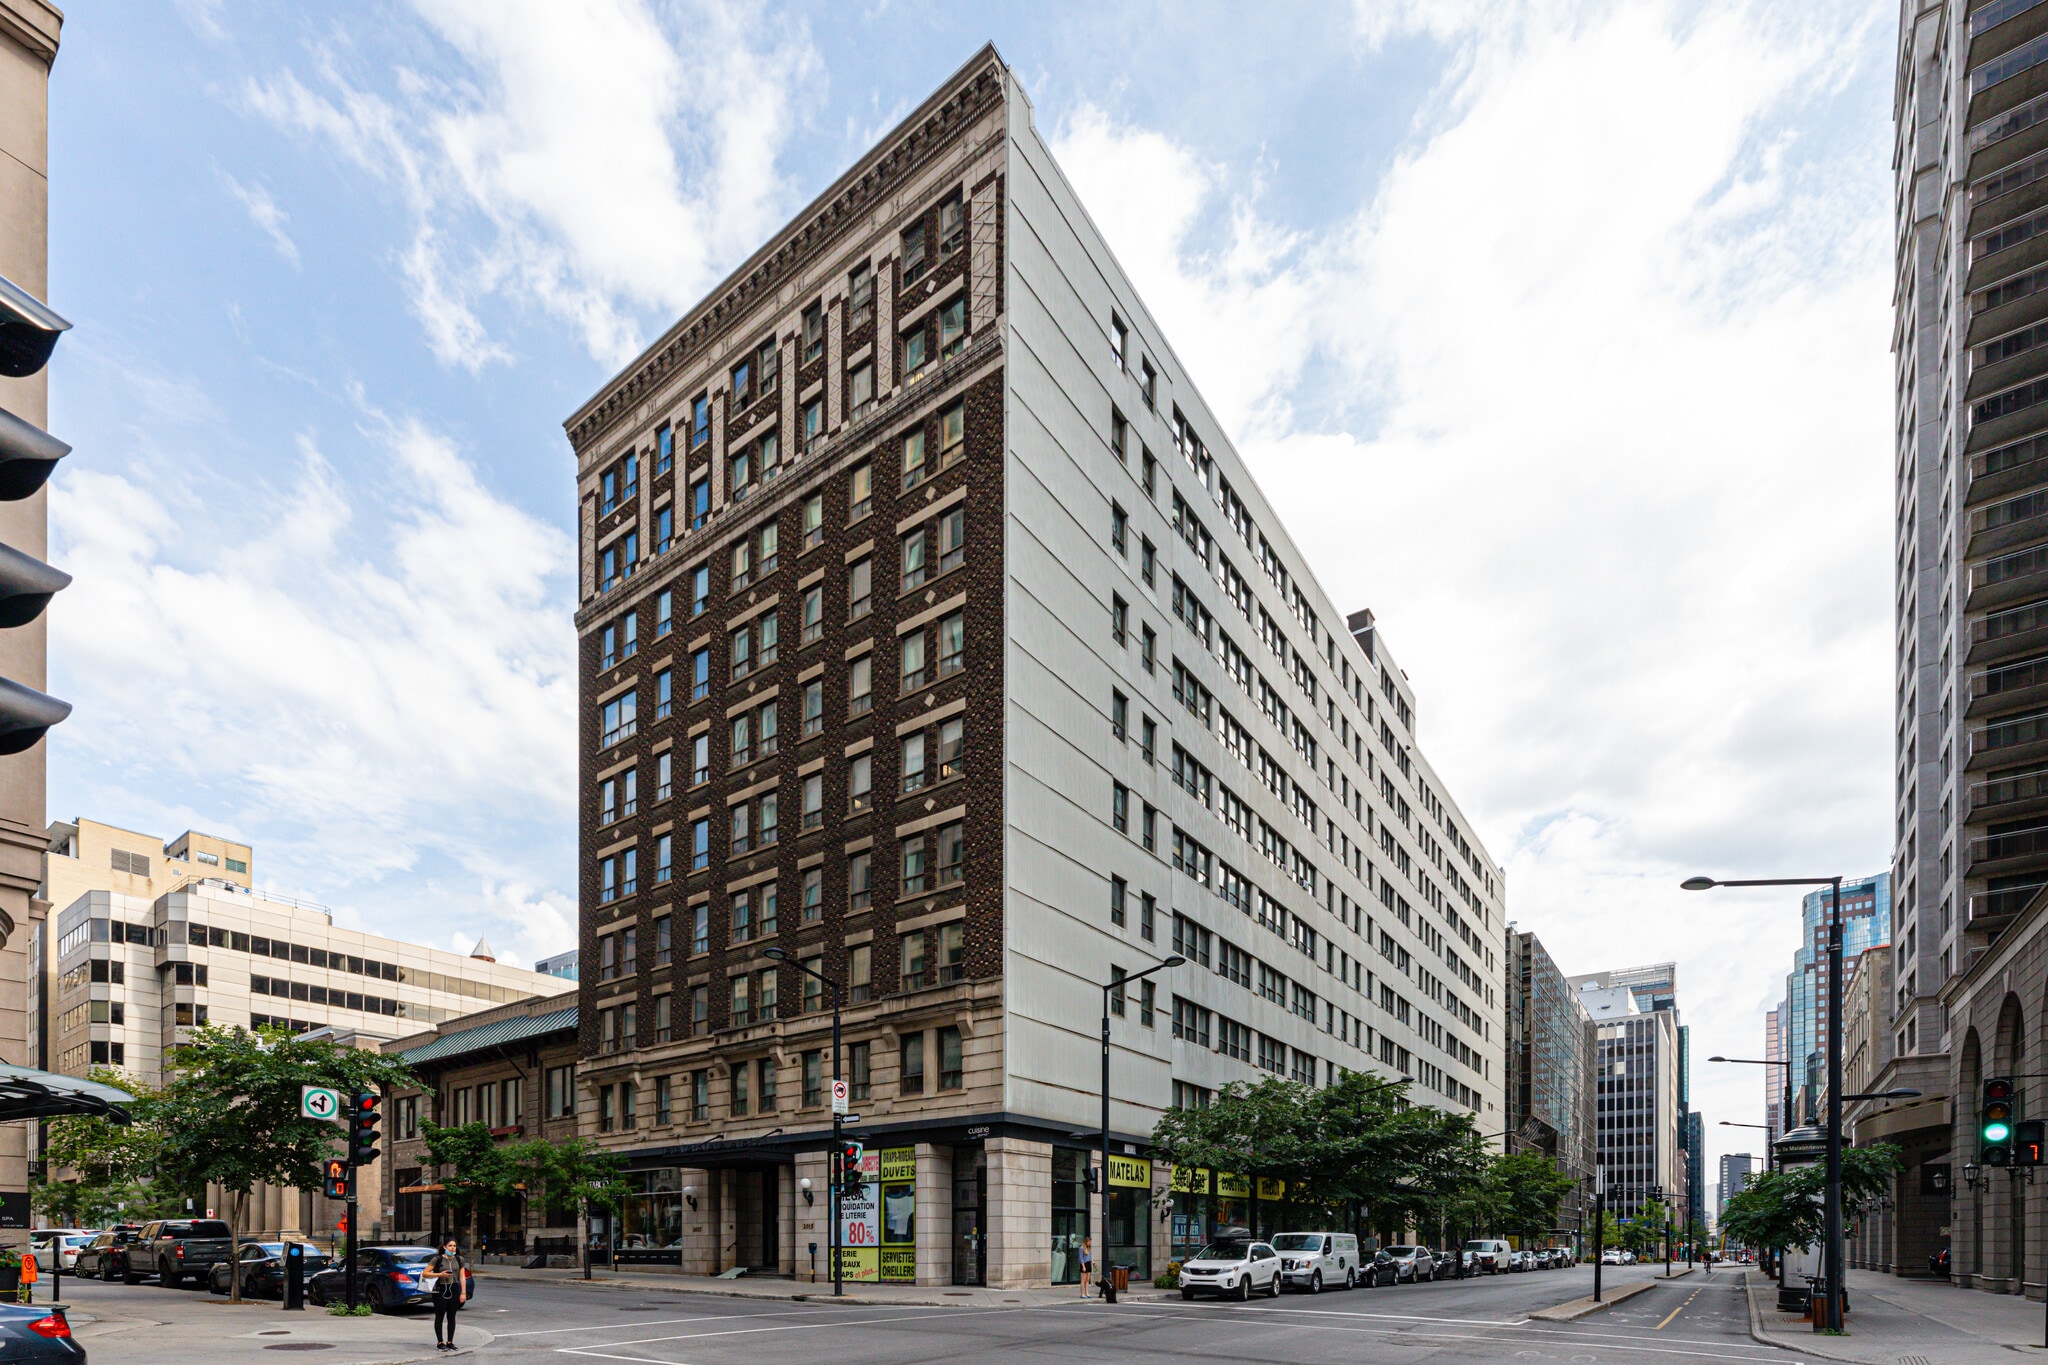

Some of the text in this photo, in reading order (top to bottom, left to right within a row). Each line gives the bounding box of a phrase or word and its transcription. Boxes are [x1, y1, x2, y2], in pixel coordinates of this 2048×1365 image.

[968, 1126, 990, 1135] cuisine
[883, 1165, 915, 1178] DUVETS
[1109, 1161, 1145, 1183] MATELAS
[845, 1212, 867, 1220] LITERIE
[883, 1252, 915, 1263] SERVIETTES
[883, 1266, 915, 1277] OREILLERS
